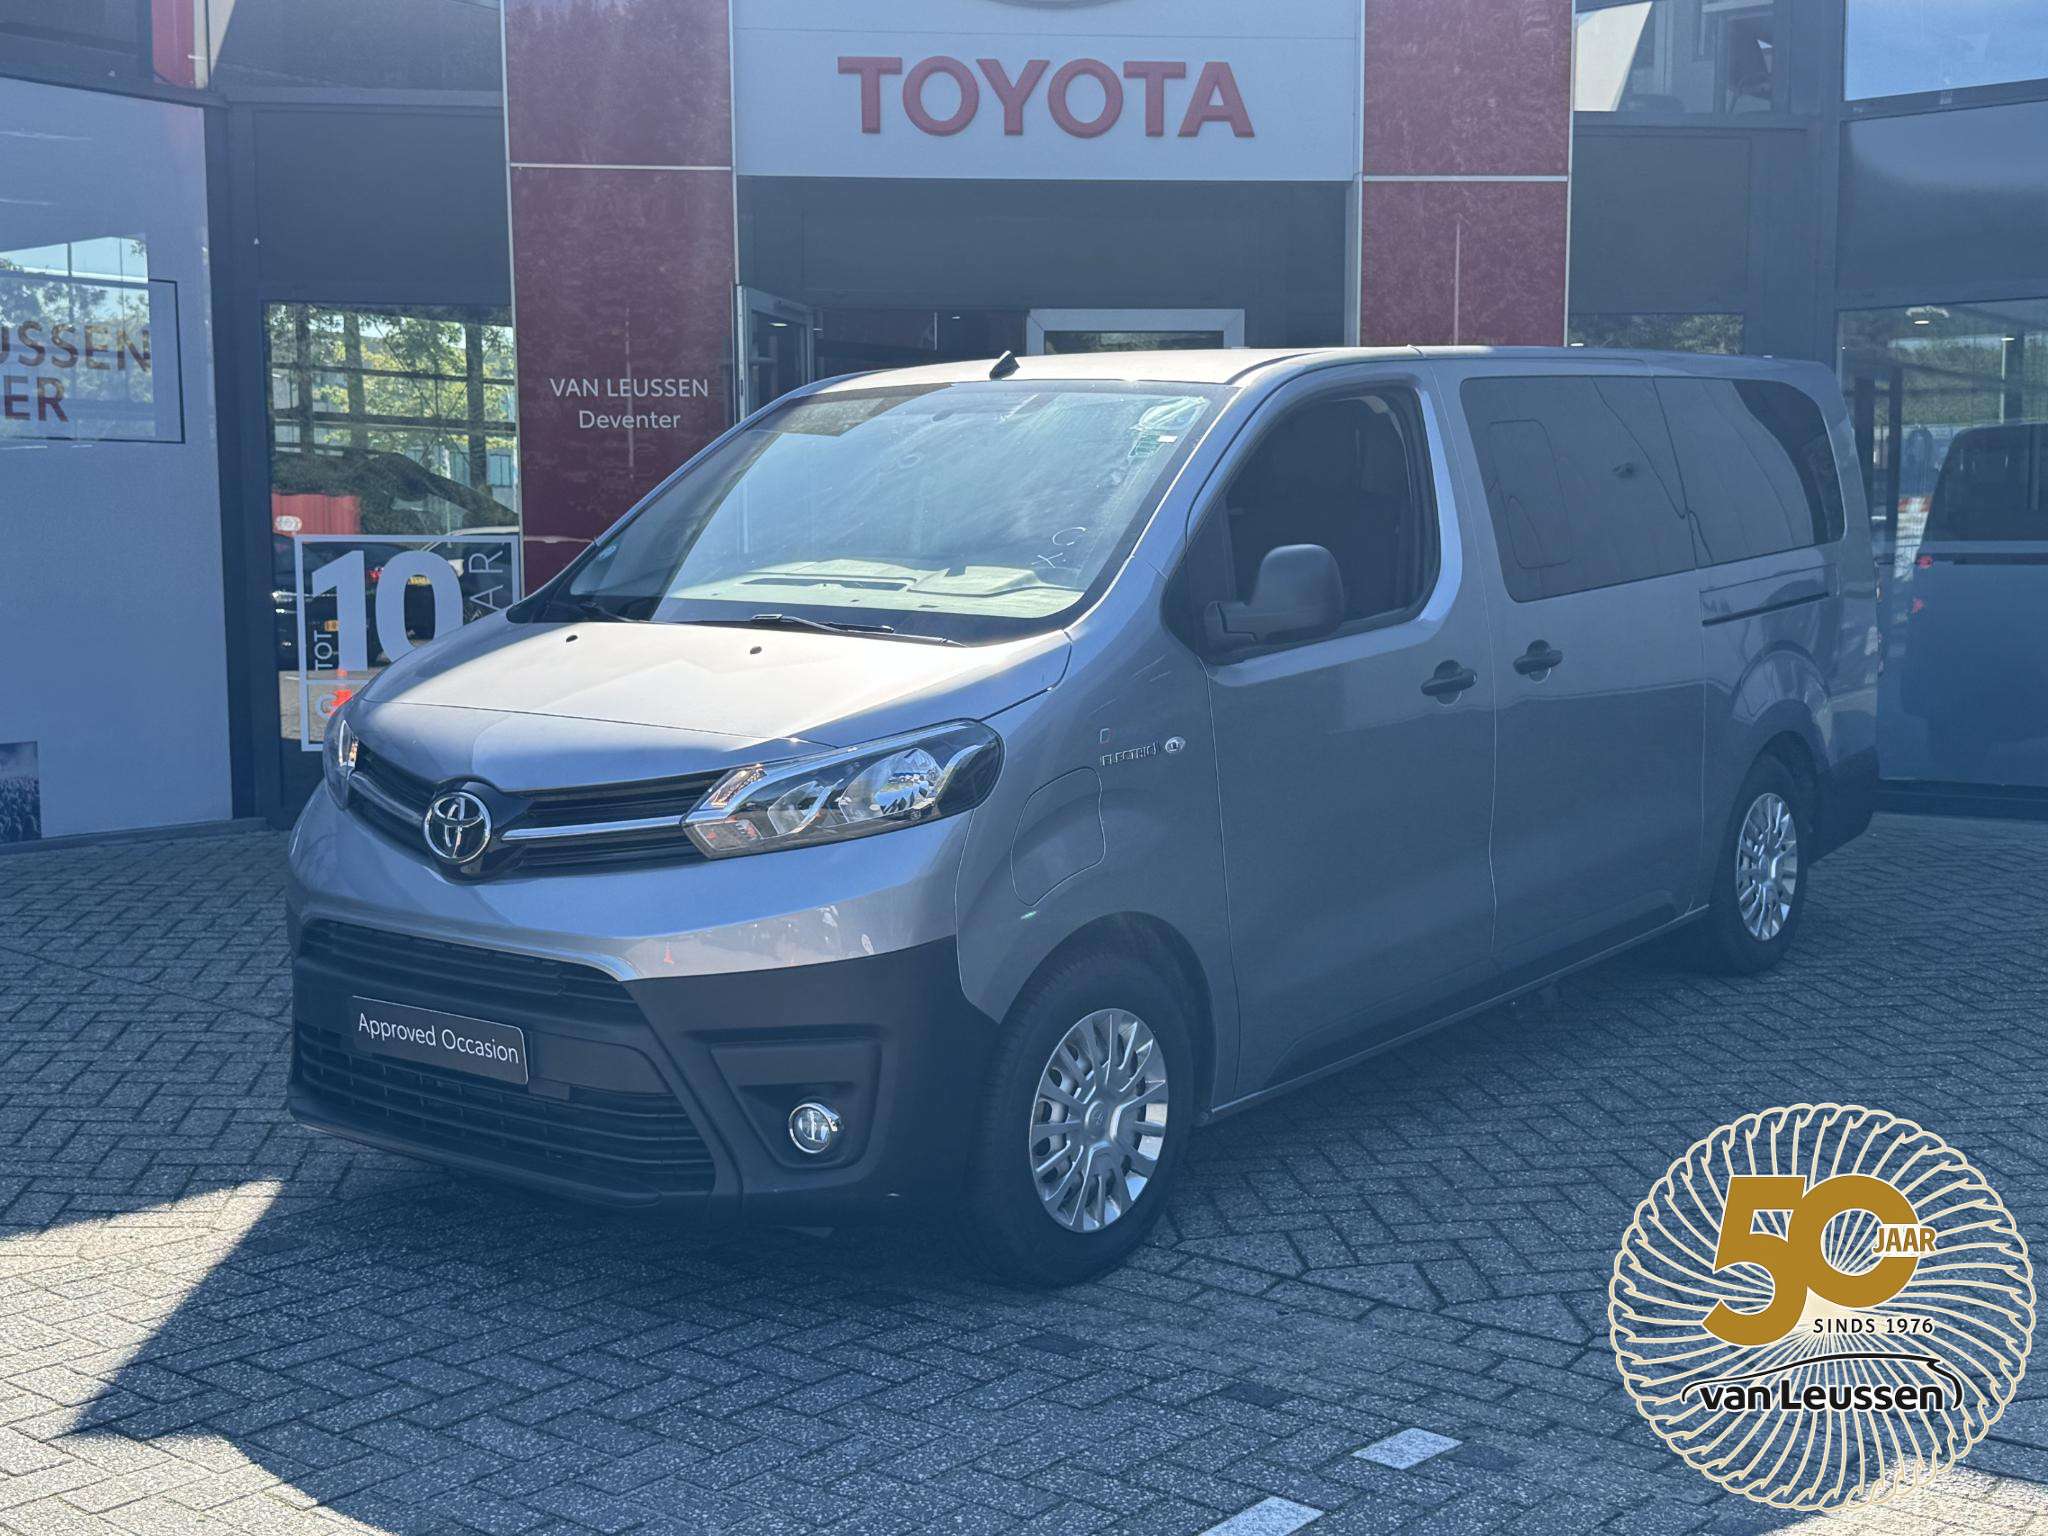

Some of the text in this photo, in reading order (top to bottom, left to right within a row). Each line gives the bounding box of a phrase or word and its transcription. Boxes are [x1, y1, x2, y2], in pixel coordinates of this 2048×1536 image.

[837, 55, 1256, 139] TOYOTA
[550, 378, 709, 397] VAN LEUSSEN
[579, 410, 681, 429] Deventer
[312, 550, 464, 671] 10
[314, 630, 333, 671] TOT
[358, 1012, 519, 1064] Approved Occasion
